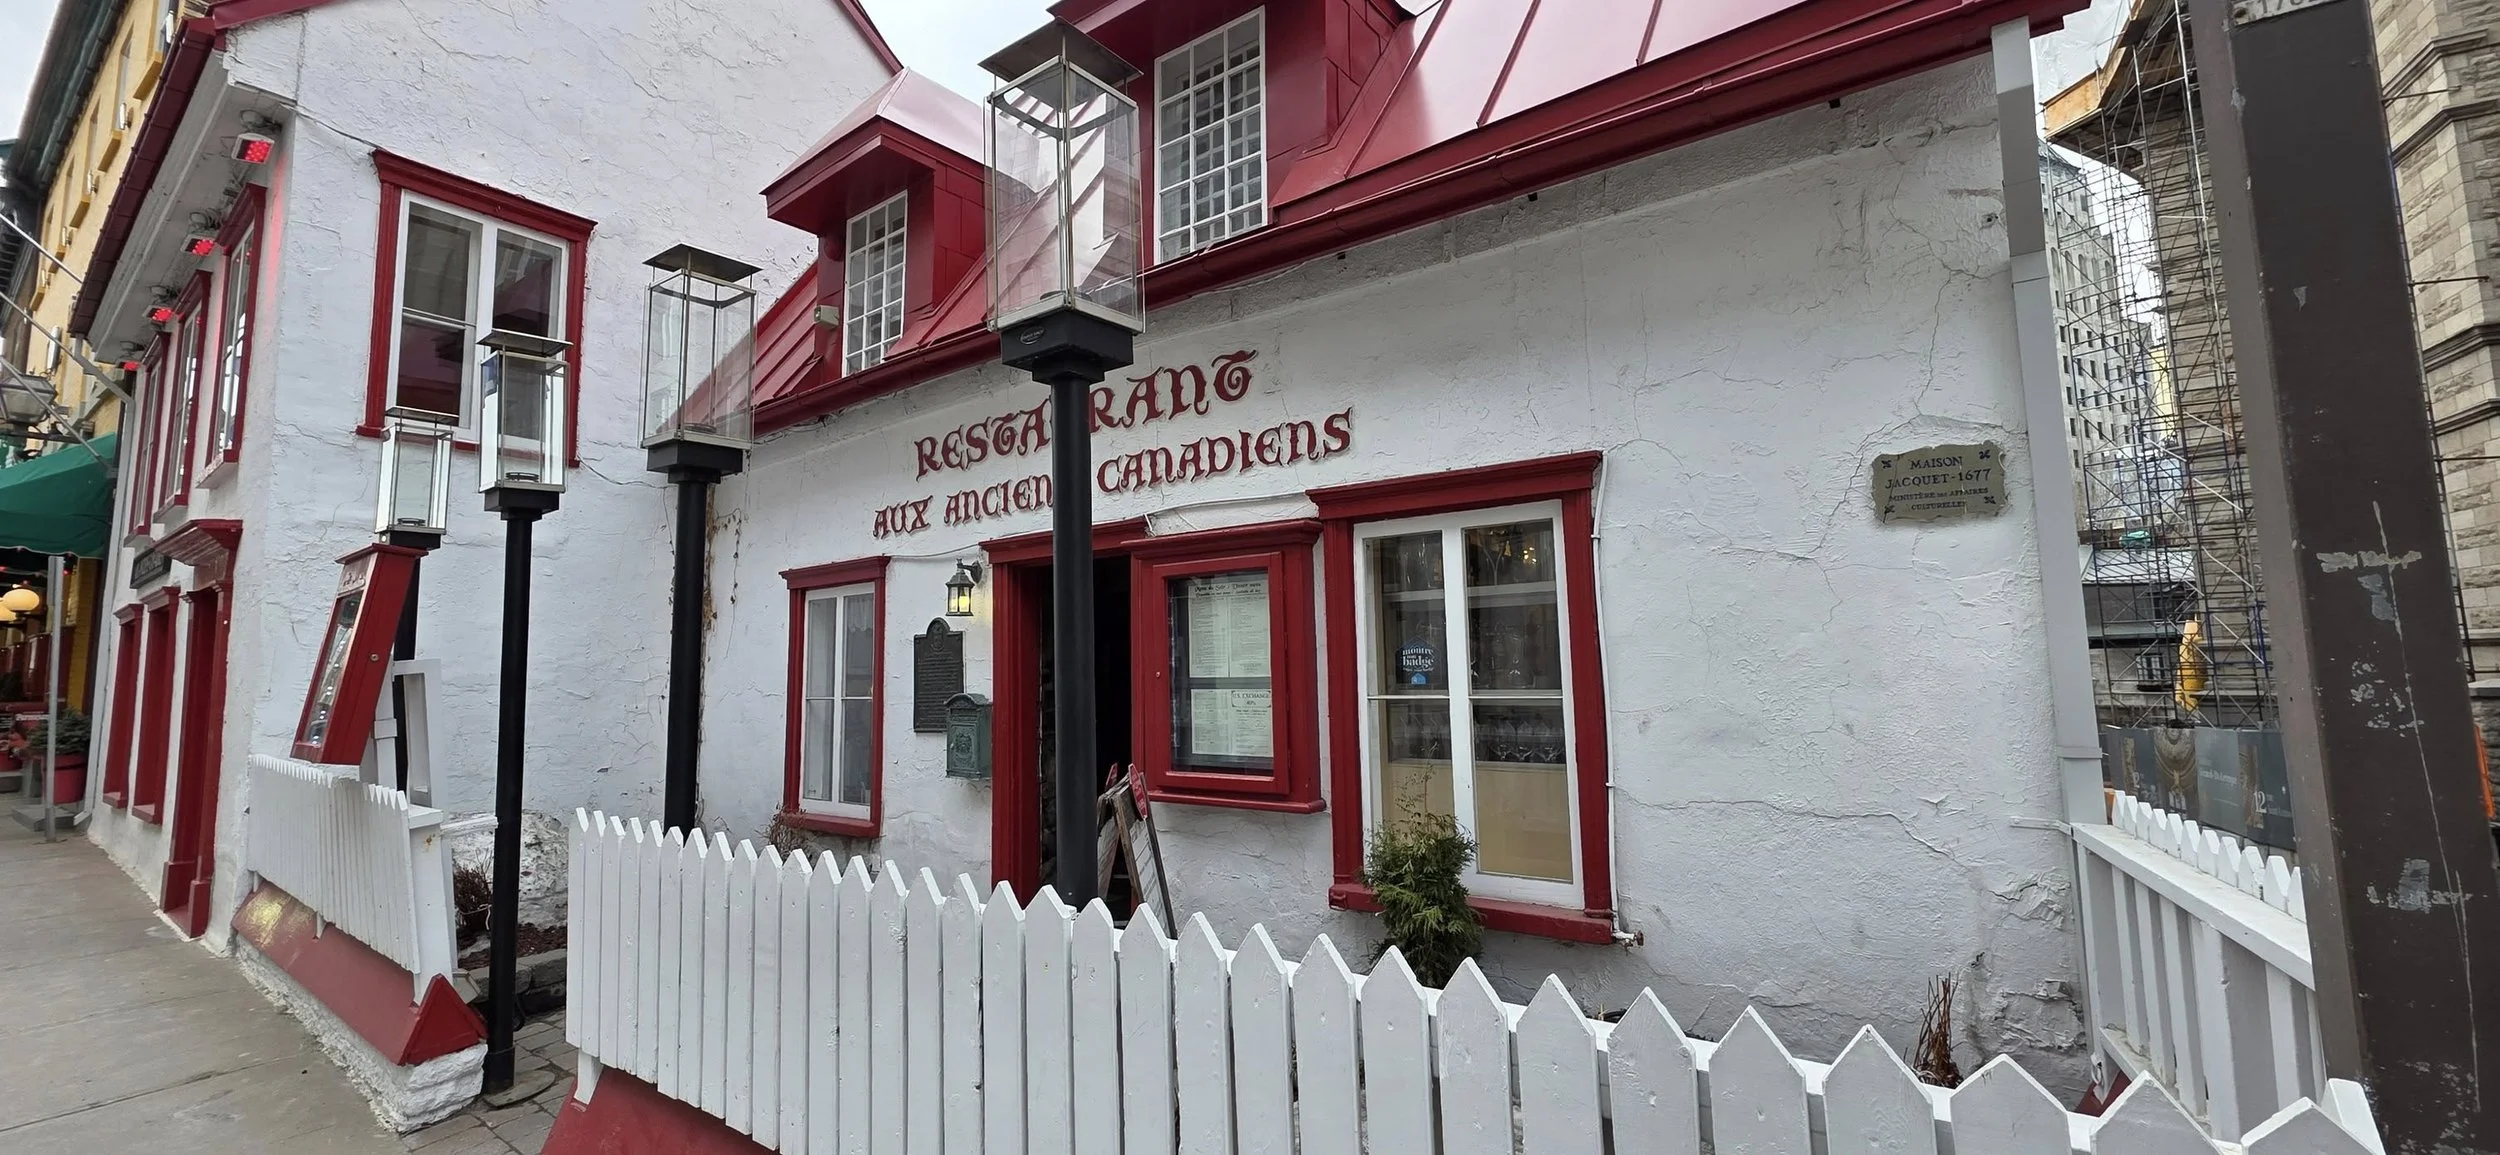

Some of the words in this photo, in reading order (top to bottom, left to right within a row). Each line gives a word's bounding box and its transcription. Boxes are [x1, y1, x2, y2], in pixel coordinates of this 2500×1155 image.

[873, 494, 934, 541] AUX
[943, 474, 1053, 526] ANCIEN
[1096, 407, 1355, 495] CANADIENS
[914, 349, 1257, 482] RESTARANT
[1909, 456, 1963, 470] MAISON
